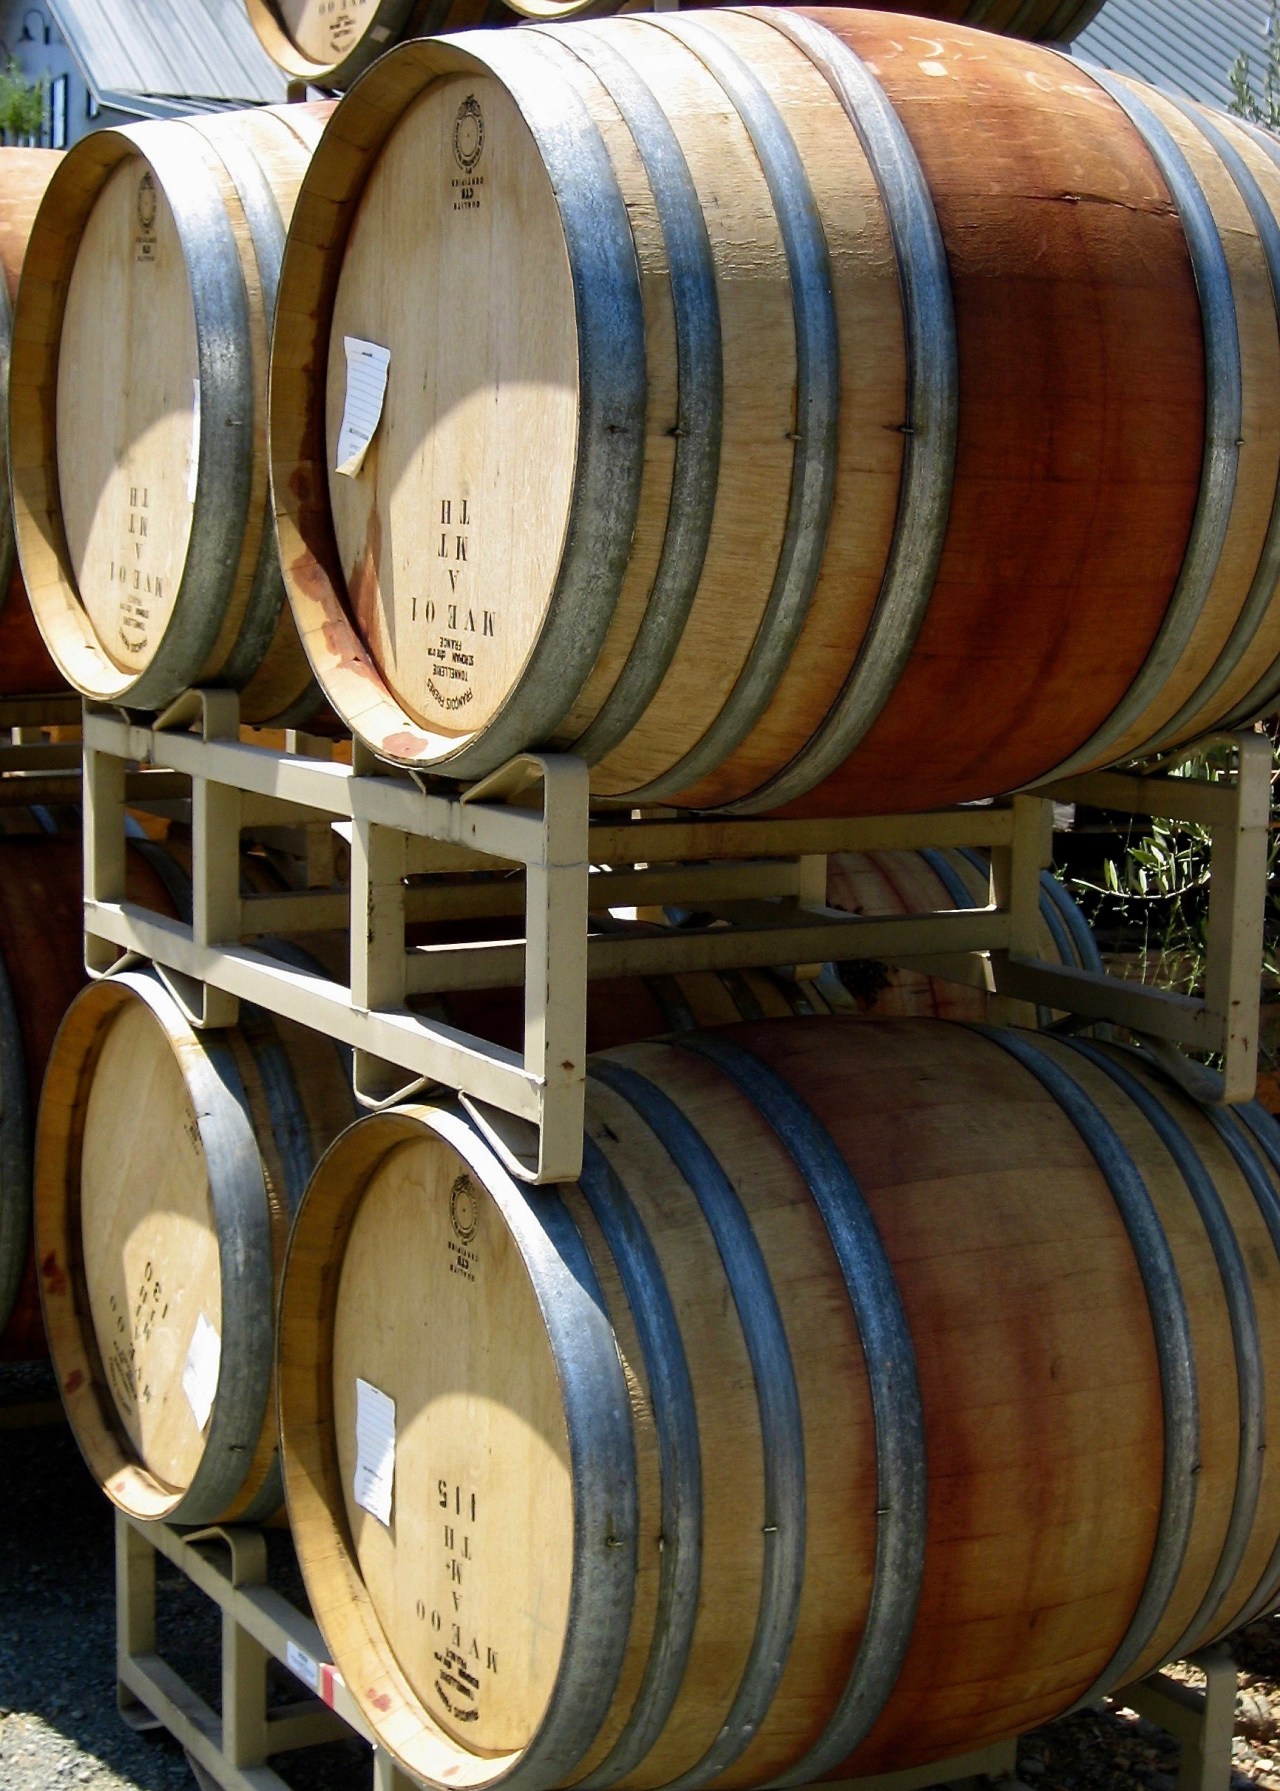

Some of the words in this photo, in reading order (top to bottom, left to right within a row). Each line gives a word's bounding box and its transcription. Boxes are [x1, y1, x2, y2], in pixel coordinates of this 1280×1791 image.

[448, 569, 460, 594] A
[439, 637, 462, 651] FRANCE
[432, 664, 468, 682] TONNELLERIE
[438, 1479, 476, 1522] 115
[452, 1591, 463, 1612] A
